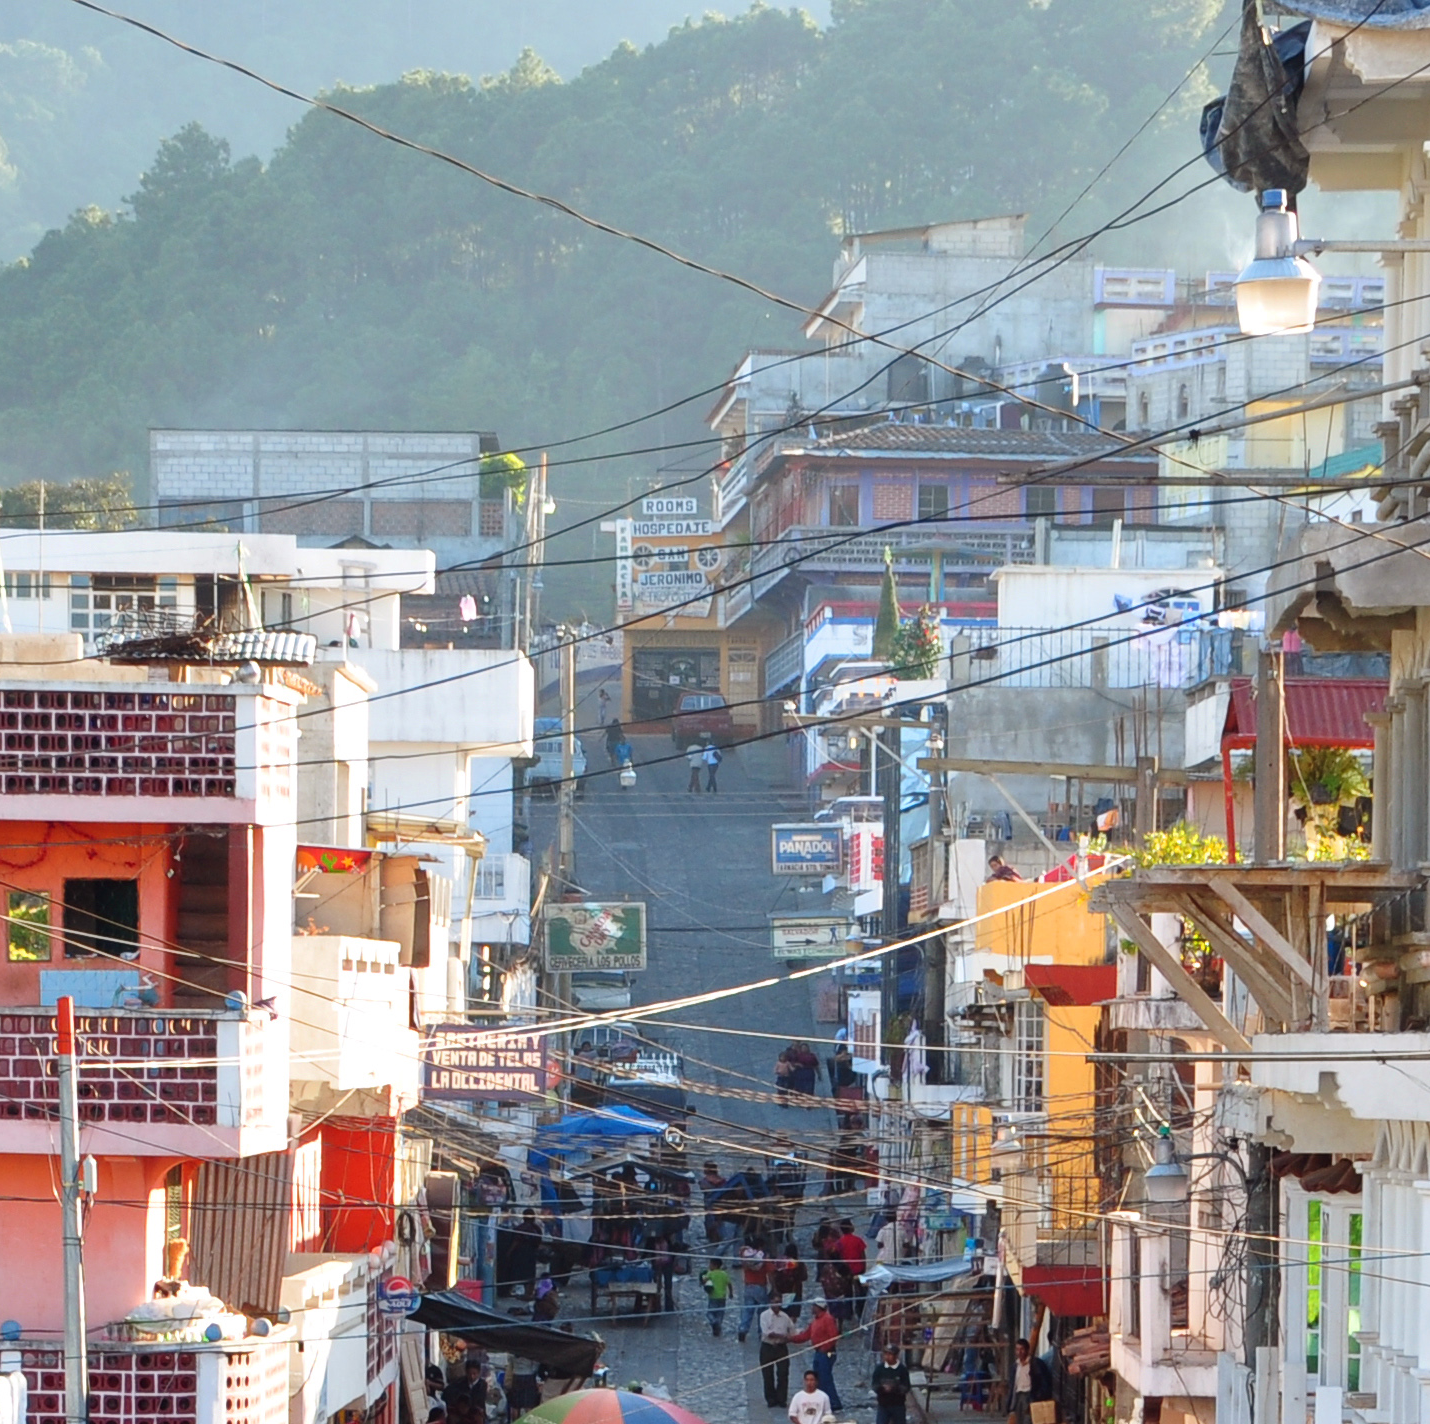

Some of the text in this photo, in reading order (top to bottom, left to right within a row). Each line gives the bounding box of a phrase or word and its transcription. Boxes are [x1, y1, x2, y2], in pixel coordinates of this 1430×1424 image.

[646, 500, 694, 512] ROOMS
[633, 521, 710, 535] HOSPEDAJE
[657, 548, 686, 560] SAN
[641, 572, 703, 586] JERONIMO
[779, 840, 835, 855] PANADOL
[551, 955, 641, 968] CERVECERIA LOS POLLOS
[531, 1034, 541, 1050] Y
[432, 1050, 542, 1068] VENTA DE TELAS
[431, 1070, 450, 1089] LA
[451, 1071, 540, 1091] OCCIDENTAL
